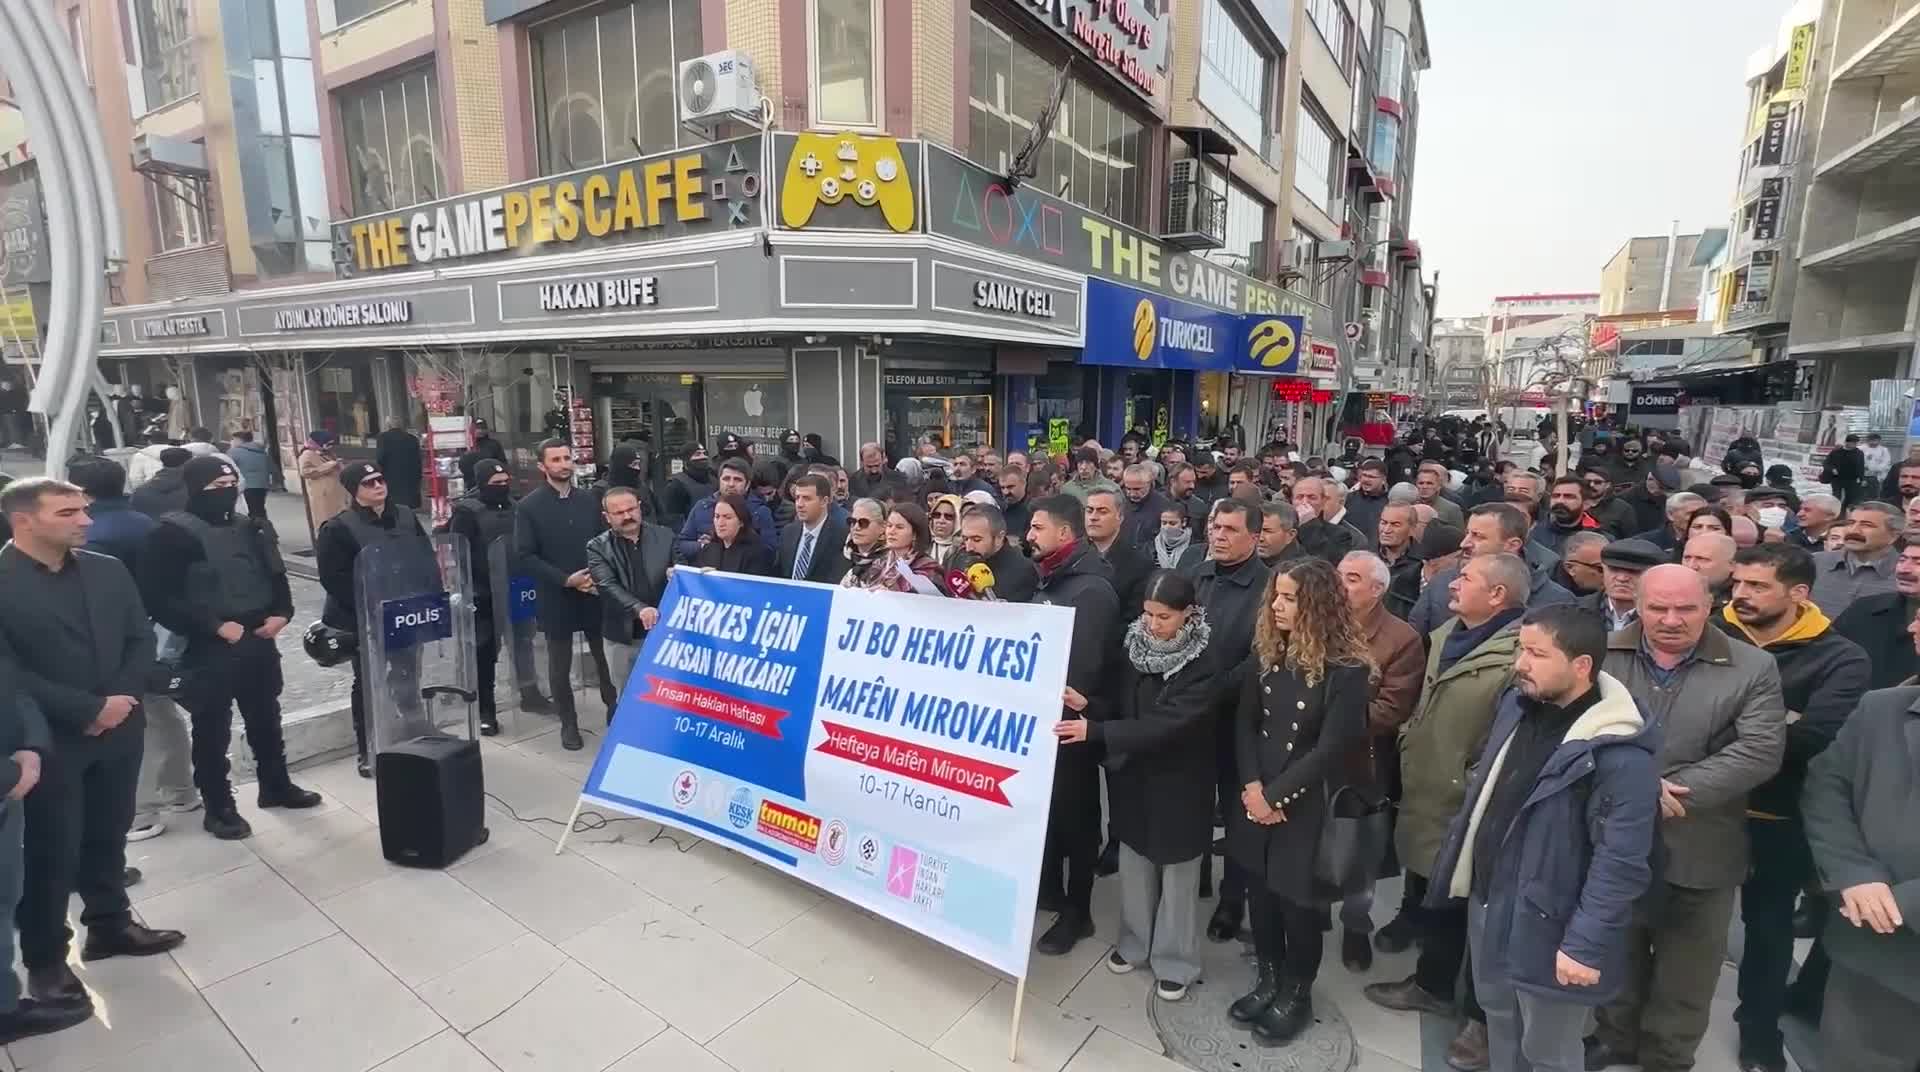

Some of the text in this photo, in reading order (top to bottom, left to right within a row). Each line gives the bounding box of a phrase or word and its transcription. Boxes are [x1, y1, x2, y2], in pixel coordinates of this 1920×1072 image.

[1074, 6, 1120, 66] Nargile
[352, 218, 408, 269] THE
[410, 196, 508, 262] GAME
[1082, 216, 1161, 288] THE
[1169, 256, 1239, 311] GAME
[1246, 285, 1277, 314] PES
[323, 303, 360, 326] DÖNER
[360, 300, 410, 324] SALONU
[540, 276, 656, 311] HAKAN BUFE
[977, 280, 1056, 317] SANAT CELL
[1160, 317, 1215, 354] TURKCELL
[1636, 393, 1675, 406] DÖNER
[395, 608, 440, 629] POLİS
[666, 595, 808, 659] HERKES İÇİN
[653, 634, 798, 696] İNSAN HAKLARI!
[838, 618, 1042, 682] JI BO HEMÛ KESÎ
[656, 681, 691, 704] İnsan
[730, 703, 766, 726] Haftası
[819, 675, 1037, 756] MAFÊN MIROVAN!
[674, 716, 746, 750] 10-17 Aralık
[830, 731, 995, 792] Hefteya Mafên Mirovan
[728, 801, 754, 821] KESK
[859, 773, 961, 822] 10-17 Kanûn
[760, 802, 818, 840] tmmob
